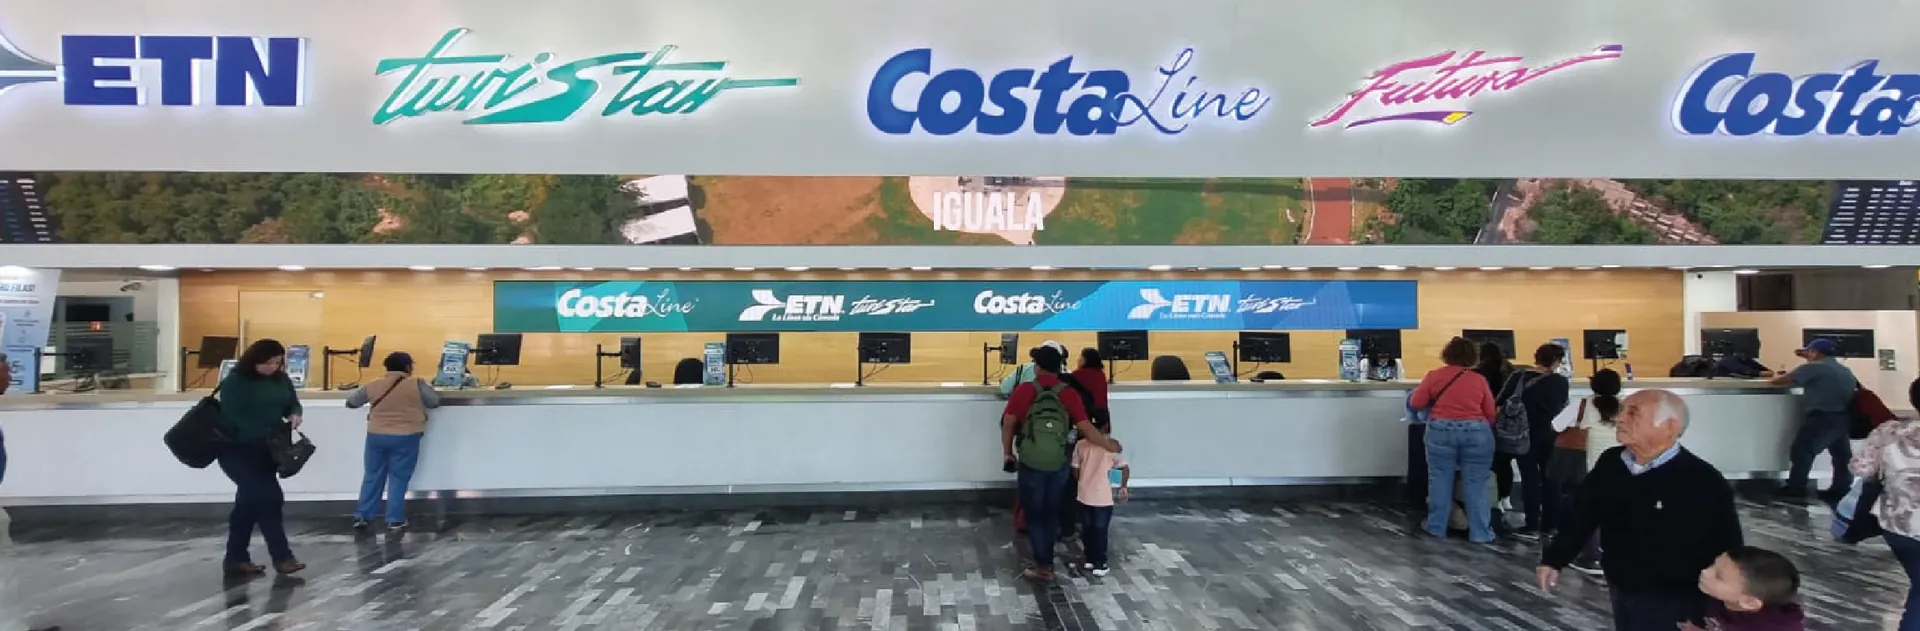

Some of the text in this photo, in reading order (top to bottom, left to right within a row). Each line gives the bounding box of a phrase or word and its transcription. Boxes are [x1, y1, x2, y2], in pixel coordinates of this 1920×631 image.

[61, 35, 303, 106] ETN
[1308, 45, 1622, 127] Futura
[867, 48, 1270, 136] Costa Line
[1674, 53, 1920, 136] Costa
[933, 192, 1044, 231] IGUALA
[557, 288, 696, 318] Costa Line
[784, 295, 844, 314] ETN
[974, 289, 1081, 314] Costa Line
[1171, 295, 1231, 312] ETN
